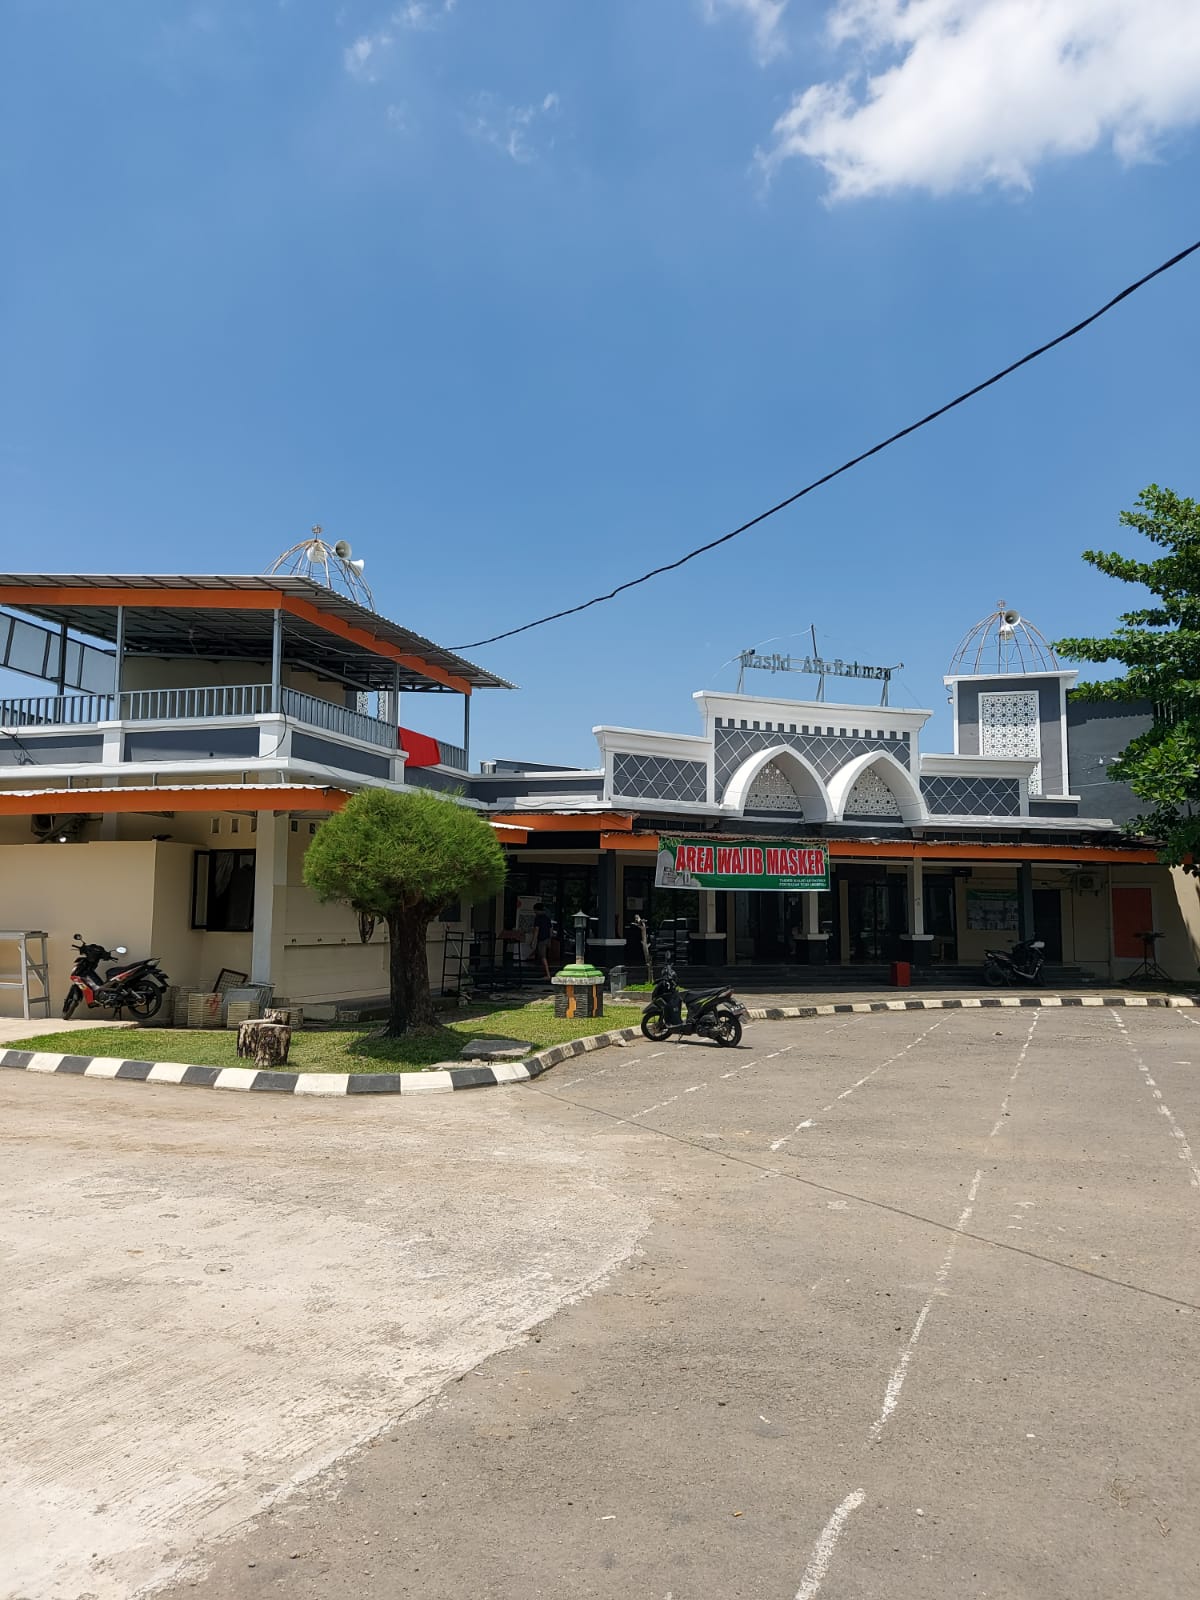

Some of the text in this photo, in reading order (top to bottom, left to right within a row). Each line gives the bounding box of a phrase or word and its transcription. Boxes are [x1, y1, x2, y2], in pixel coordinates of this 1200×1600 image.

[741, 650, 790, 674] Masjid
[675, 846, 826, 876] AREA WAJIB MASKER
